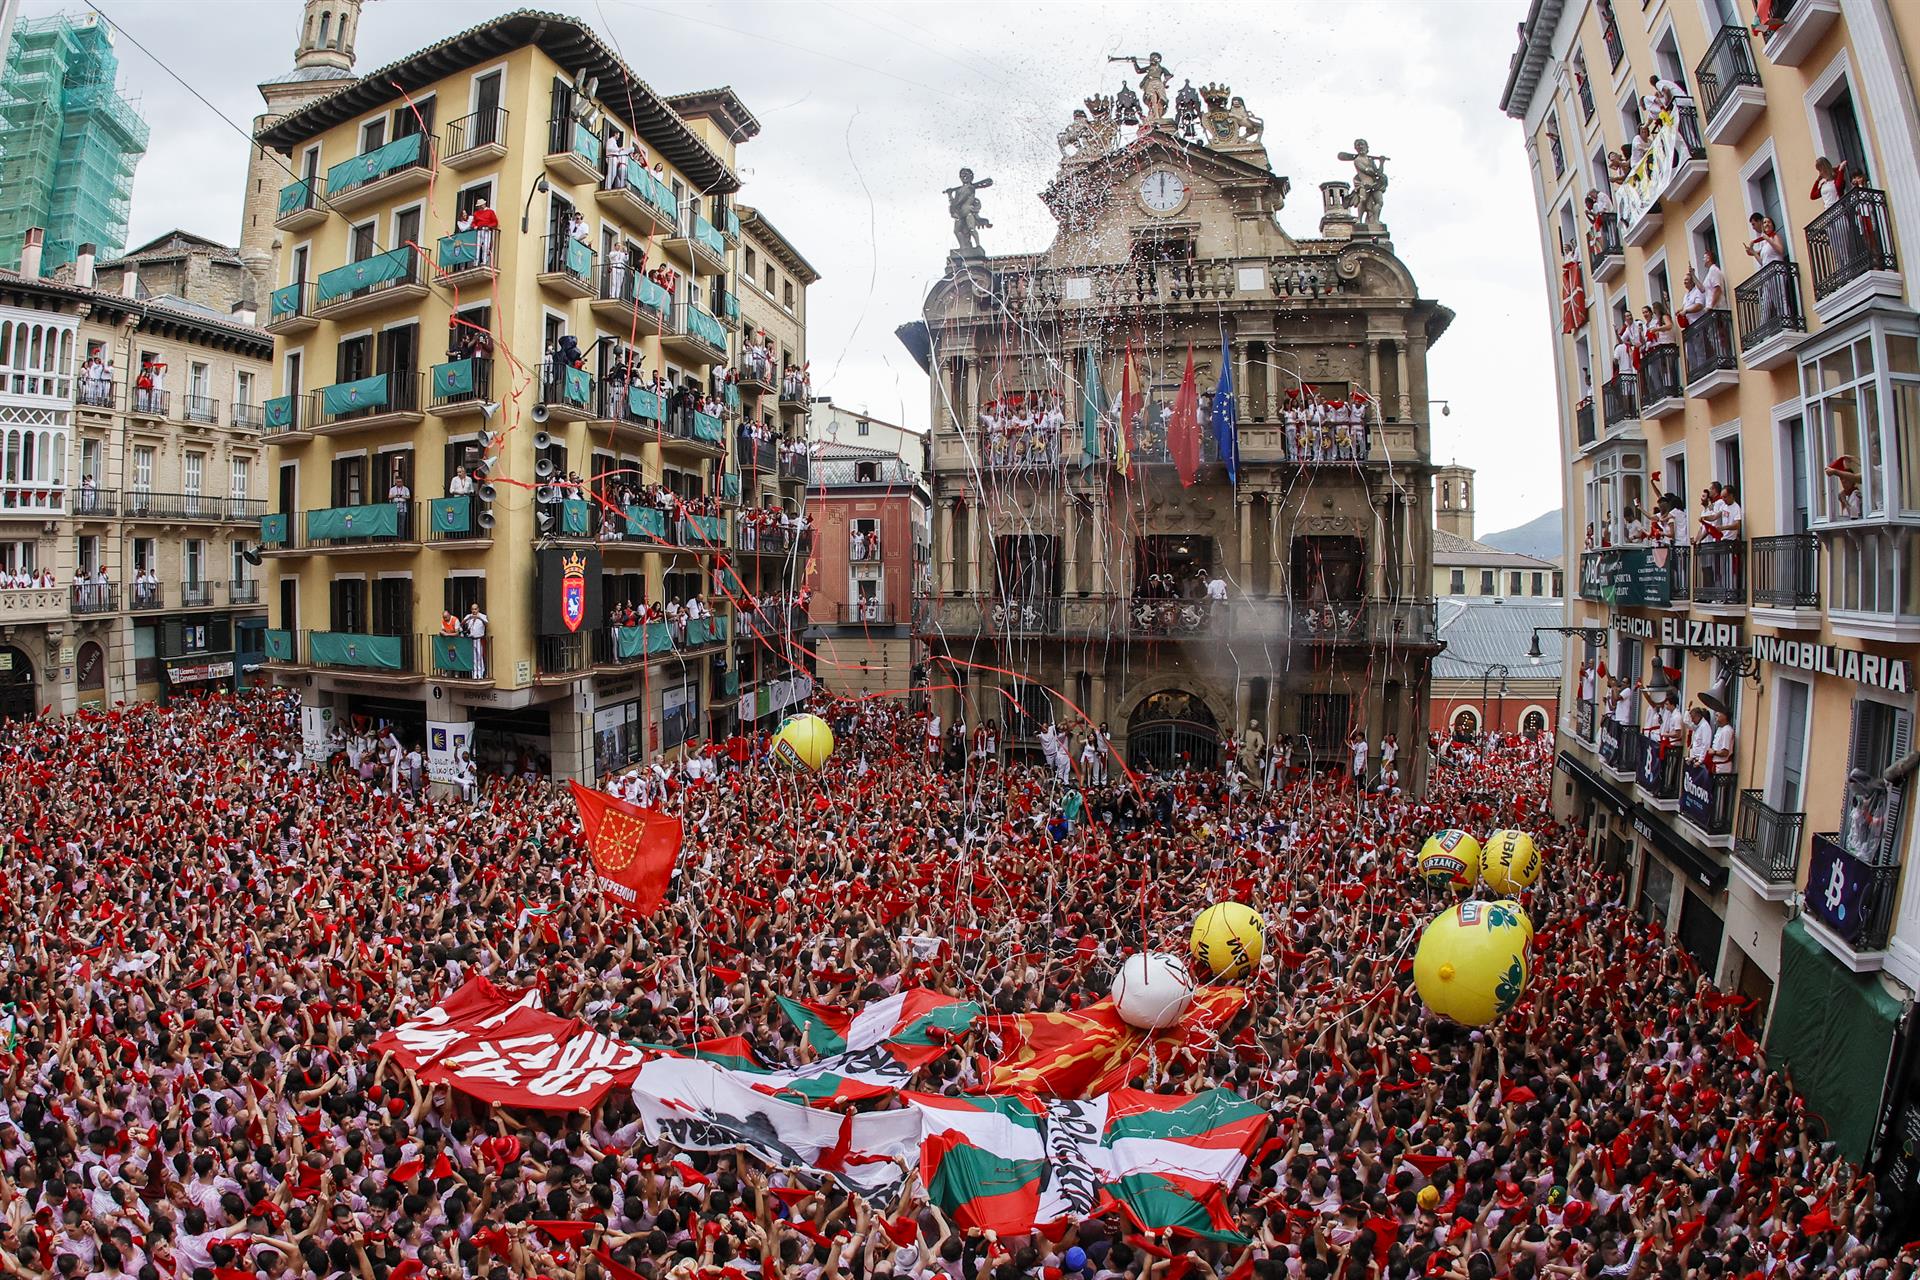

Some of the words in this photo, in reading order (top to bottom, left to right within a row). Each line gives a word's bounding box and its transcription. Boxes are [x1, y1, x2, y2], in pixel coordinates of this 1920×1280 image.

[1608, 614, 1653, 638] AGENCIA
[1661, 617, 1738, 647] ELIZARI
[1752, 635, 1906, 693] INMOBILIARIA
[1423, 858, 1463, 873] URZANTE
[1752, 931, 1759, 947] 2
